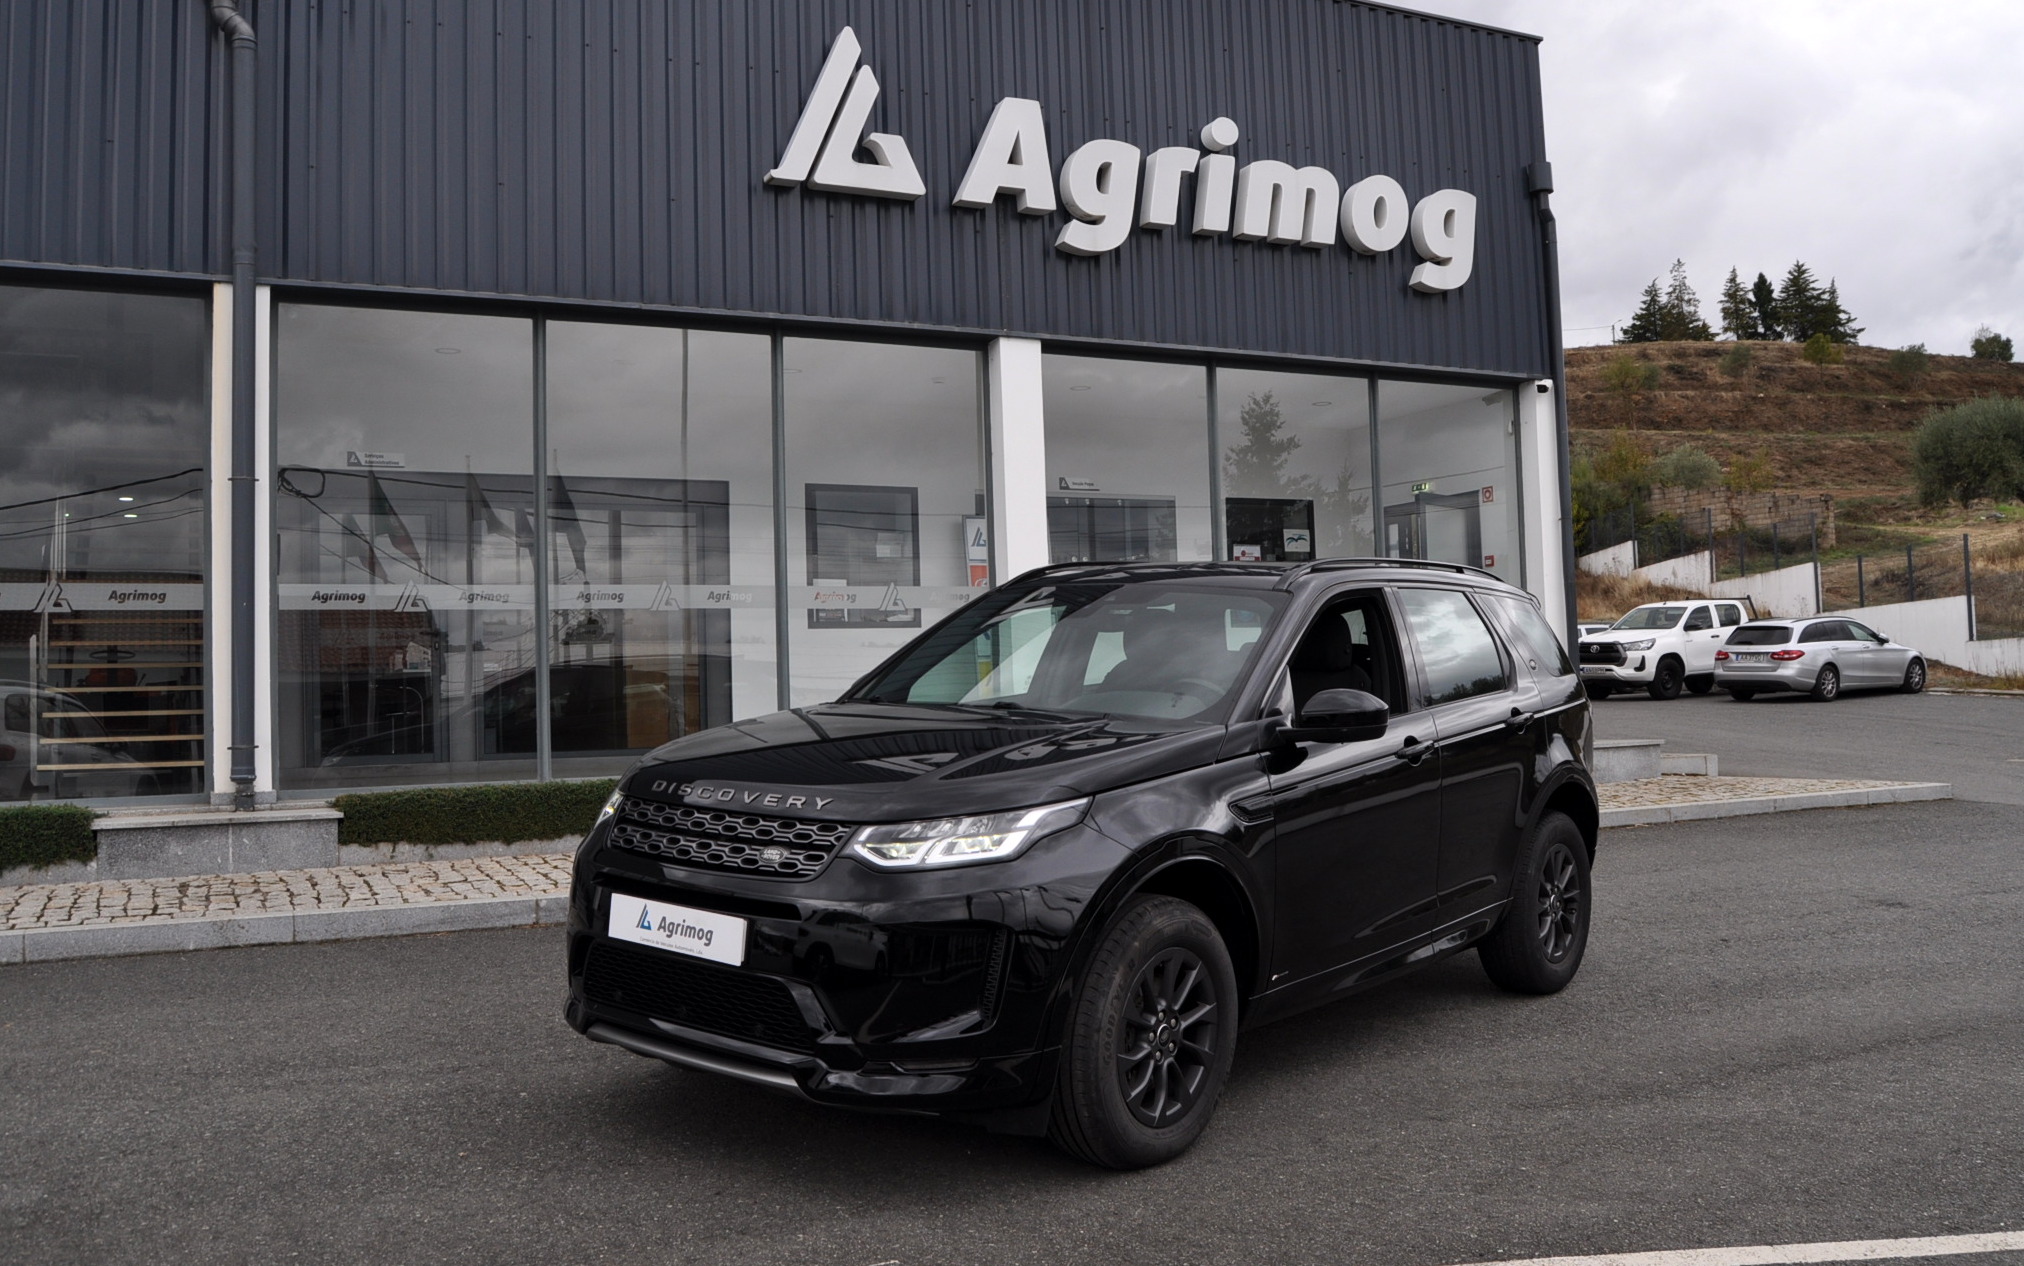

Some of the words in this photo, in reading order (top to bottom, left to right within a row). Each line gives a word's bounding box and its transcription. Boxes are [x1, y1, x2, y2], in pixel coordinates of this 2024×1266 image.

[952, 97, 1477, 294] Agrimog
[108, 589, 167, 604] Agrimog
[311, 590, 366, 603] Agrimog
[459, 590, 510, 603] Agrimog
[576, 590, 625, 603] Agrimog
[707, 590, 753, 604] Agrimog
[651, 780, 834, 810] DISCOVERY
[656, 915, 714, 947] Agrimog
